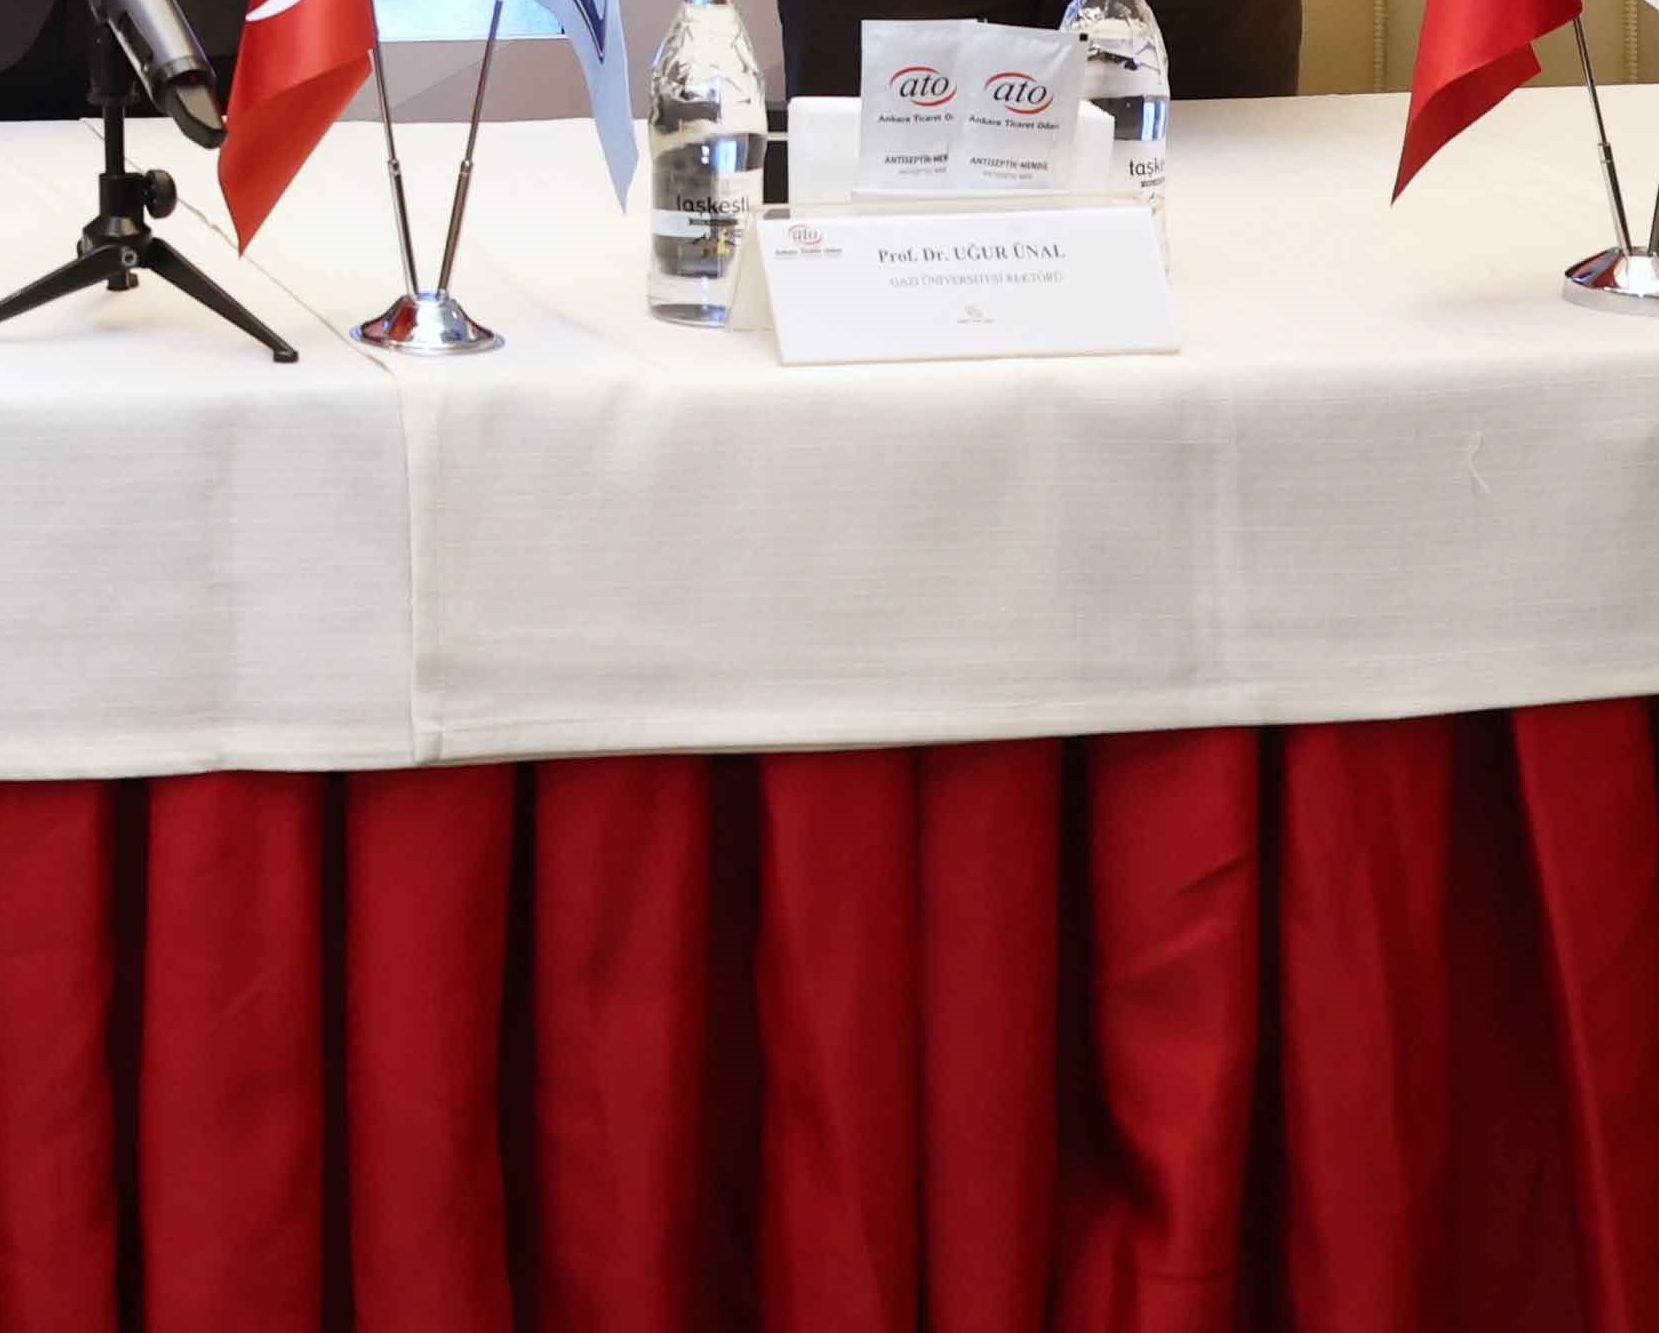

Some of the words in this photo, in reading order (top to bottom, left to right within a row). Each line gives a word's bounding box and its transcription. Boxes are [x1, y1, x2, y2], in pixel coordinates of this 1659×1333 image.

[899, 73, 950, 98] ato
[992, 79, 1048, 105] ato
[877, 247, 917, 264] Prof.
[922, 247, 950, 263] Dr.
[953, 242, 1009, 262] UĞUR
[1012, 240, 1067, 261] ÜNAL
